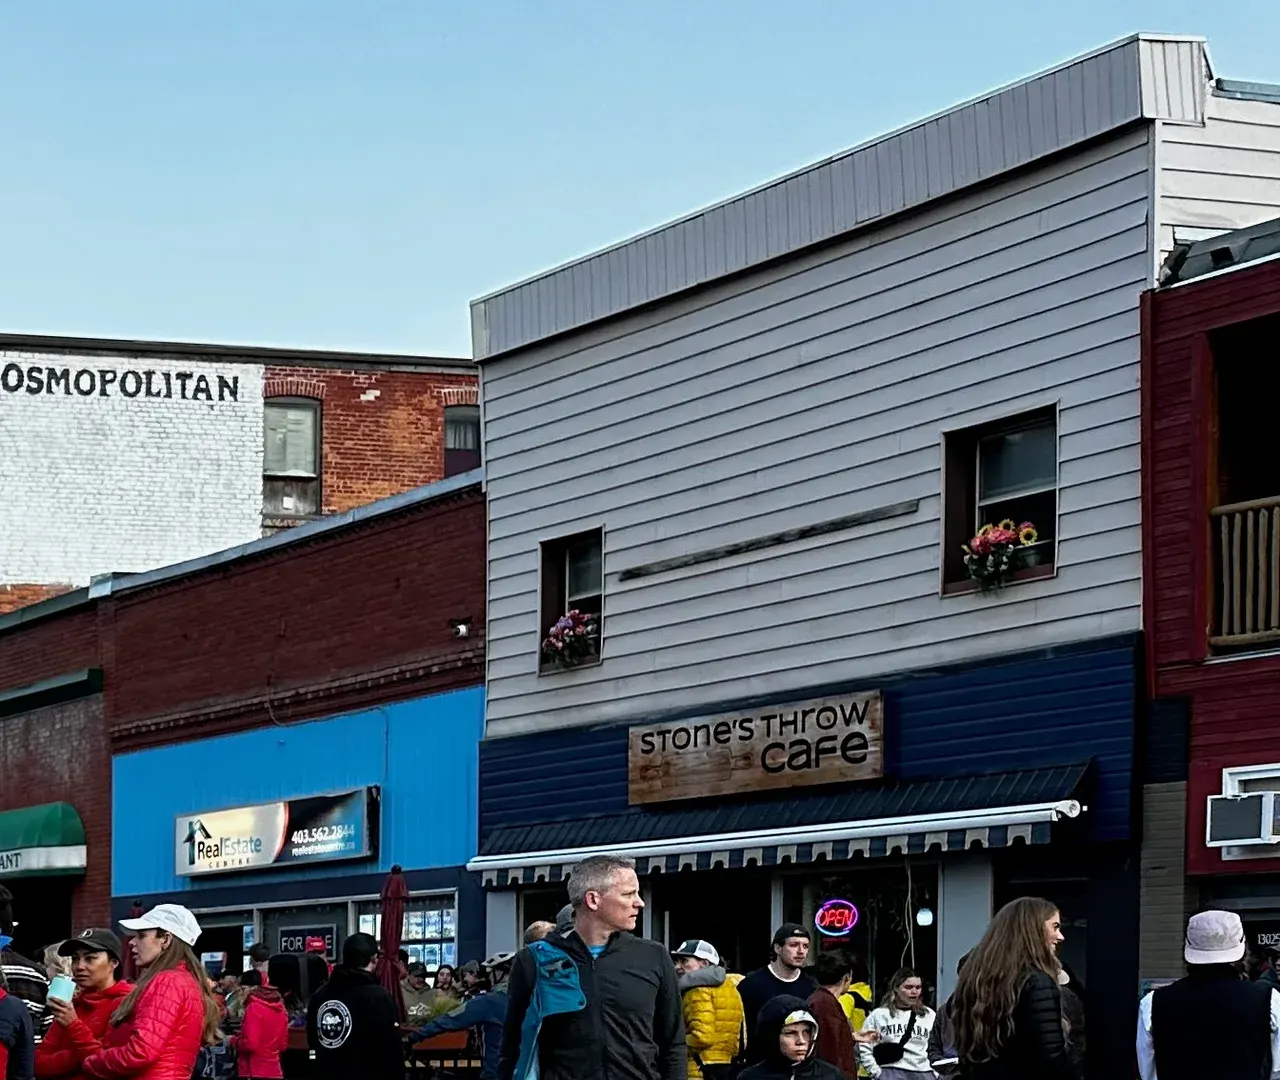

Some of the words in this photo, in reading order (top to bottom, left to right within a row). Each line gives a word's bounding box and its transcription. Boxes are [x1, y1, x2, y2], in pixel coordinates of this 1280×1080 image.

[291, 824, 355, 844] 403.562.2844
[818, 908, 854, 927] OPEN
[281, 936, 304, 951] FOR
[885, 1023, 929, 1038] NIARA
